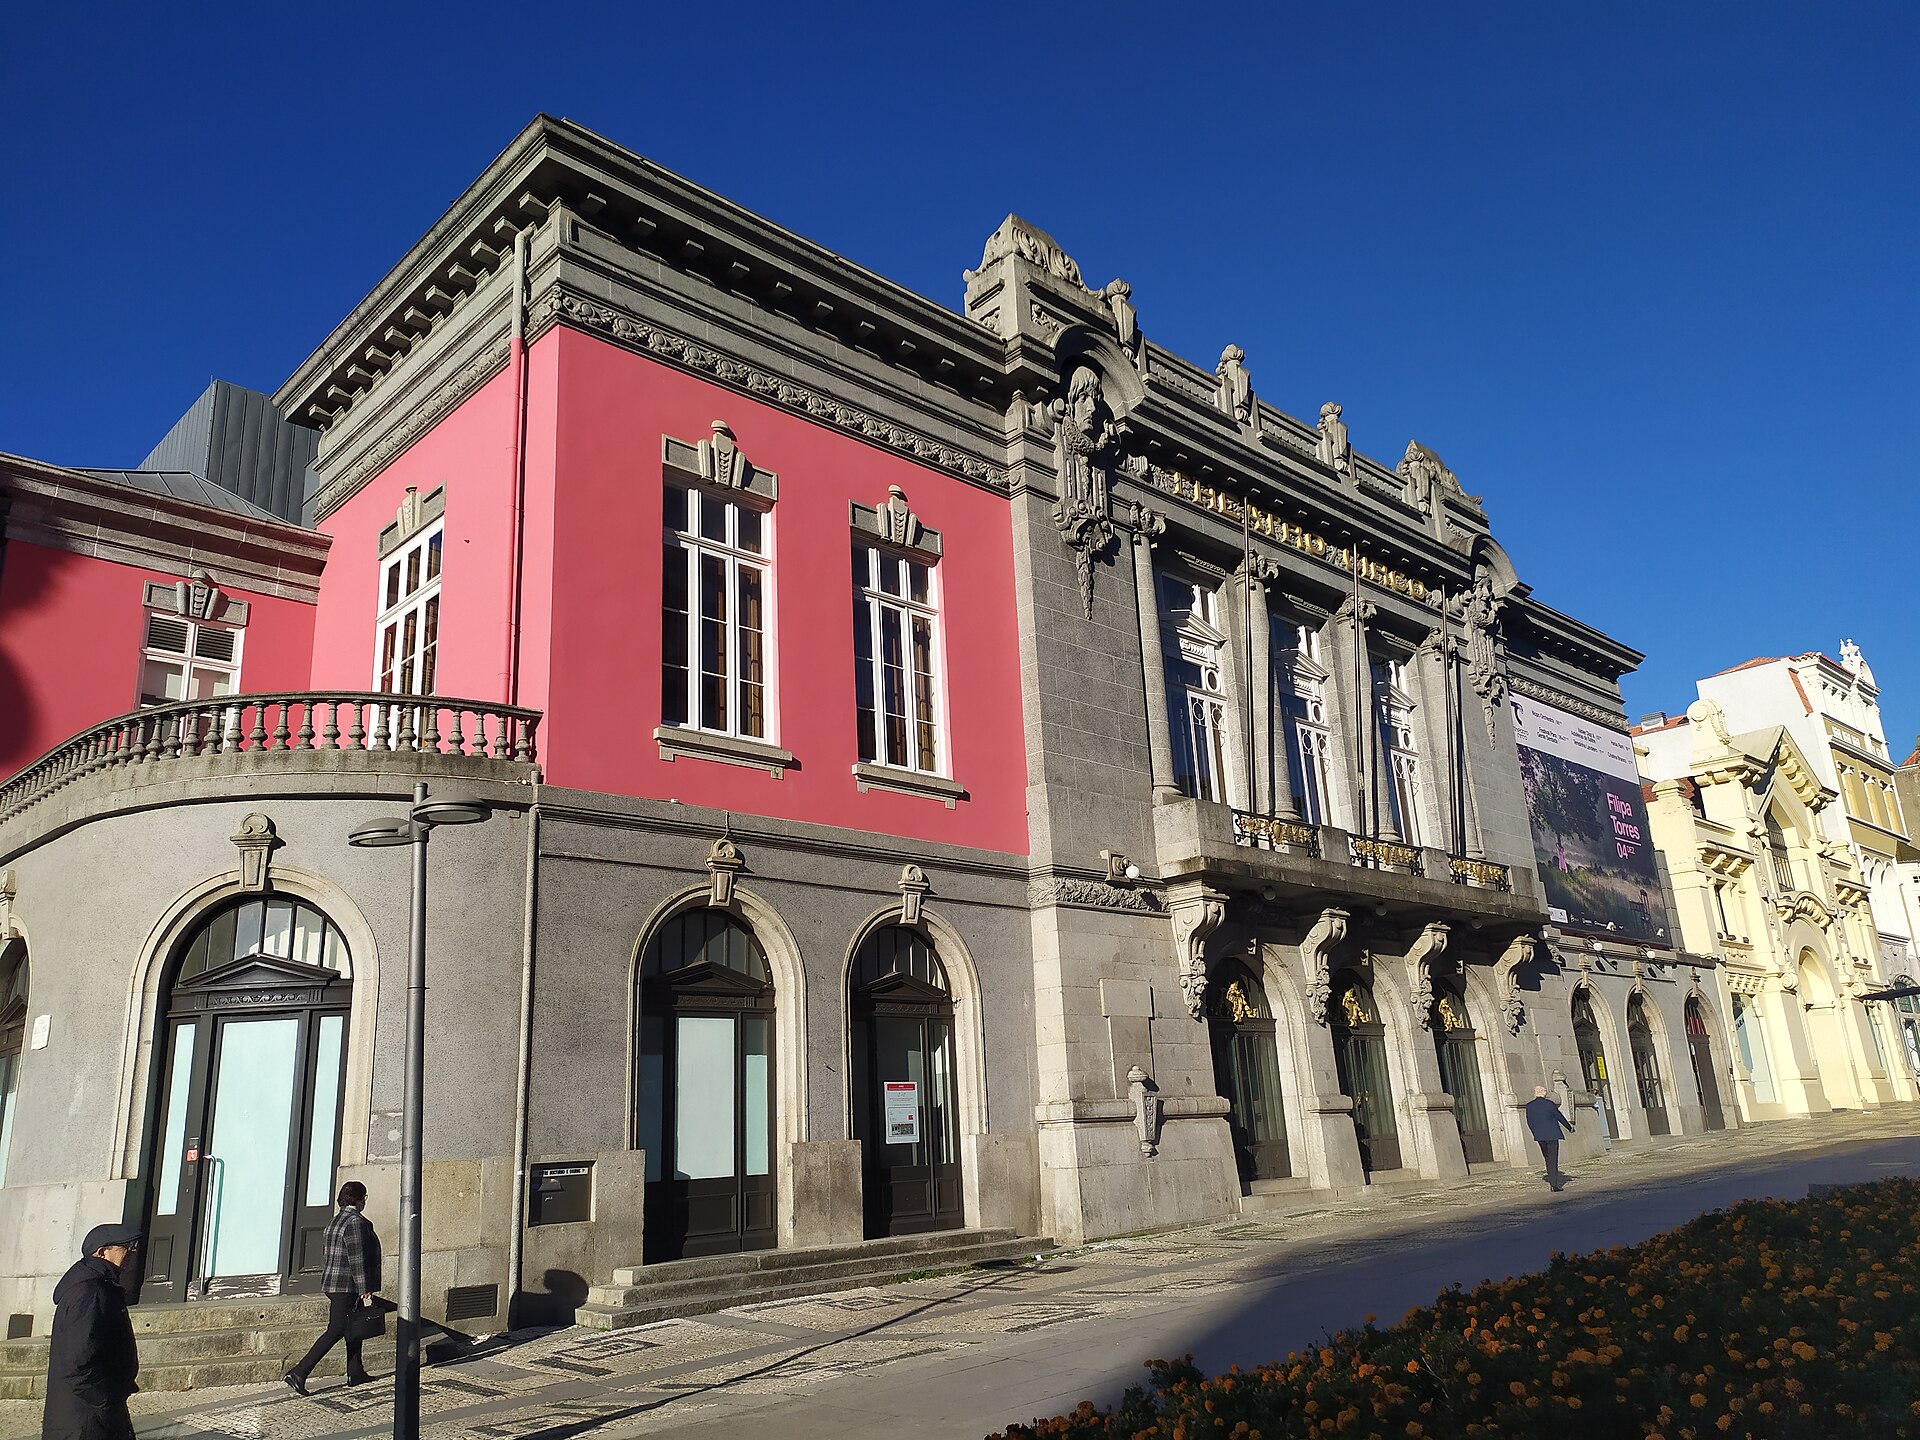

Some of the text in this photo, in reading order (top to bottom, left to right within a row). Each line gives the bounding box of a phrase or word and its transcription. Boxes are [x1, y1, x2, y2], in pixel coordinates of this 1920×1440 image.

[1168, 469, 1426, 600] THEATRO CIRCO
[1606, 792, 1632, 819] Filipa
[1610, 815, 1640, 840] Torres
